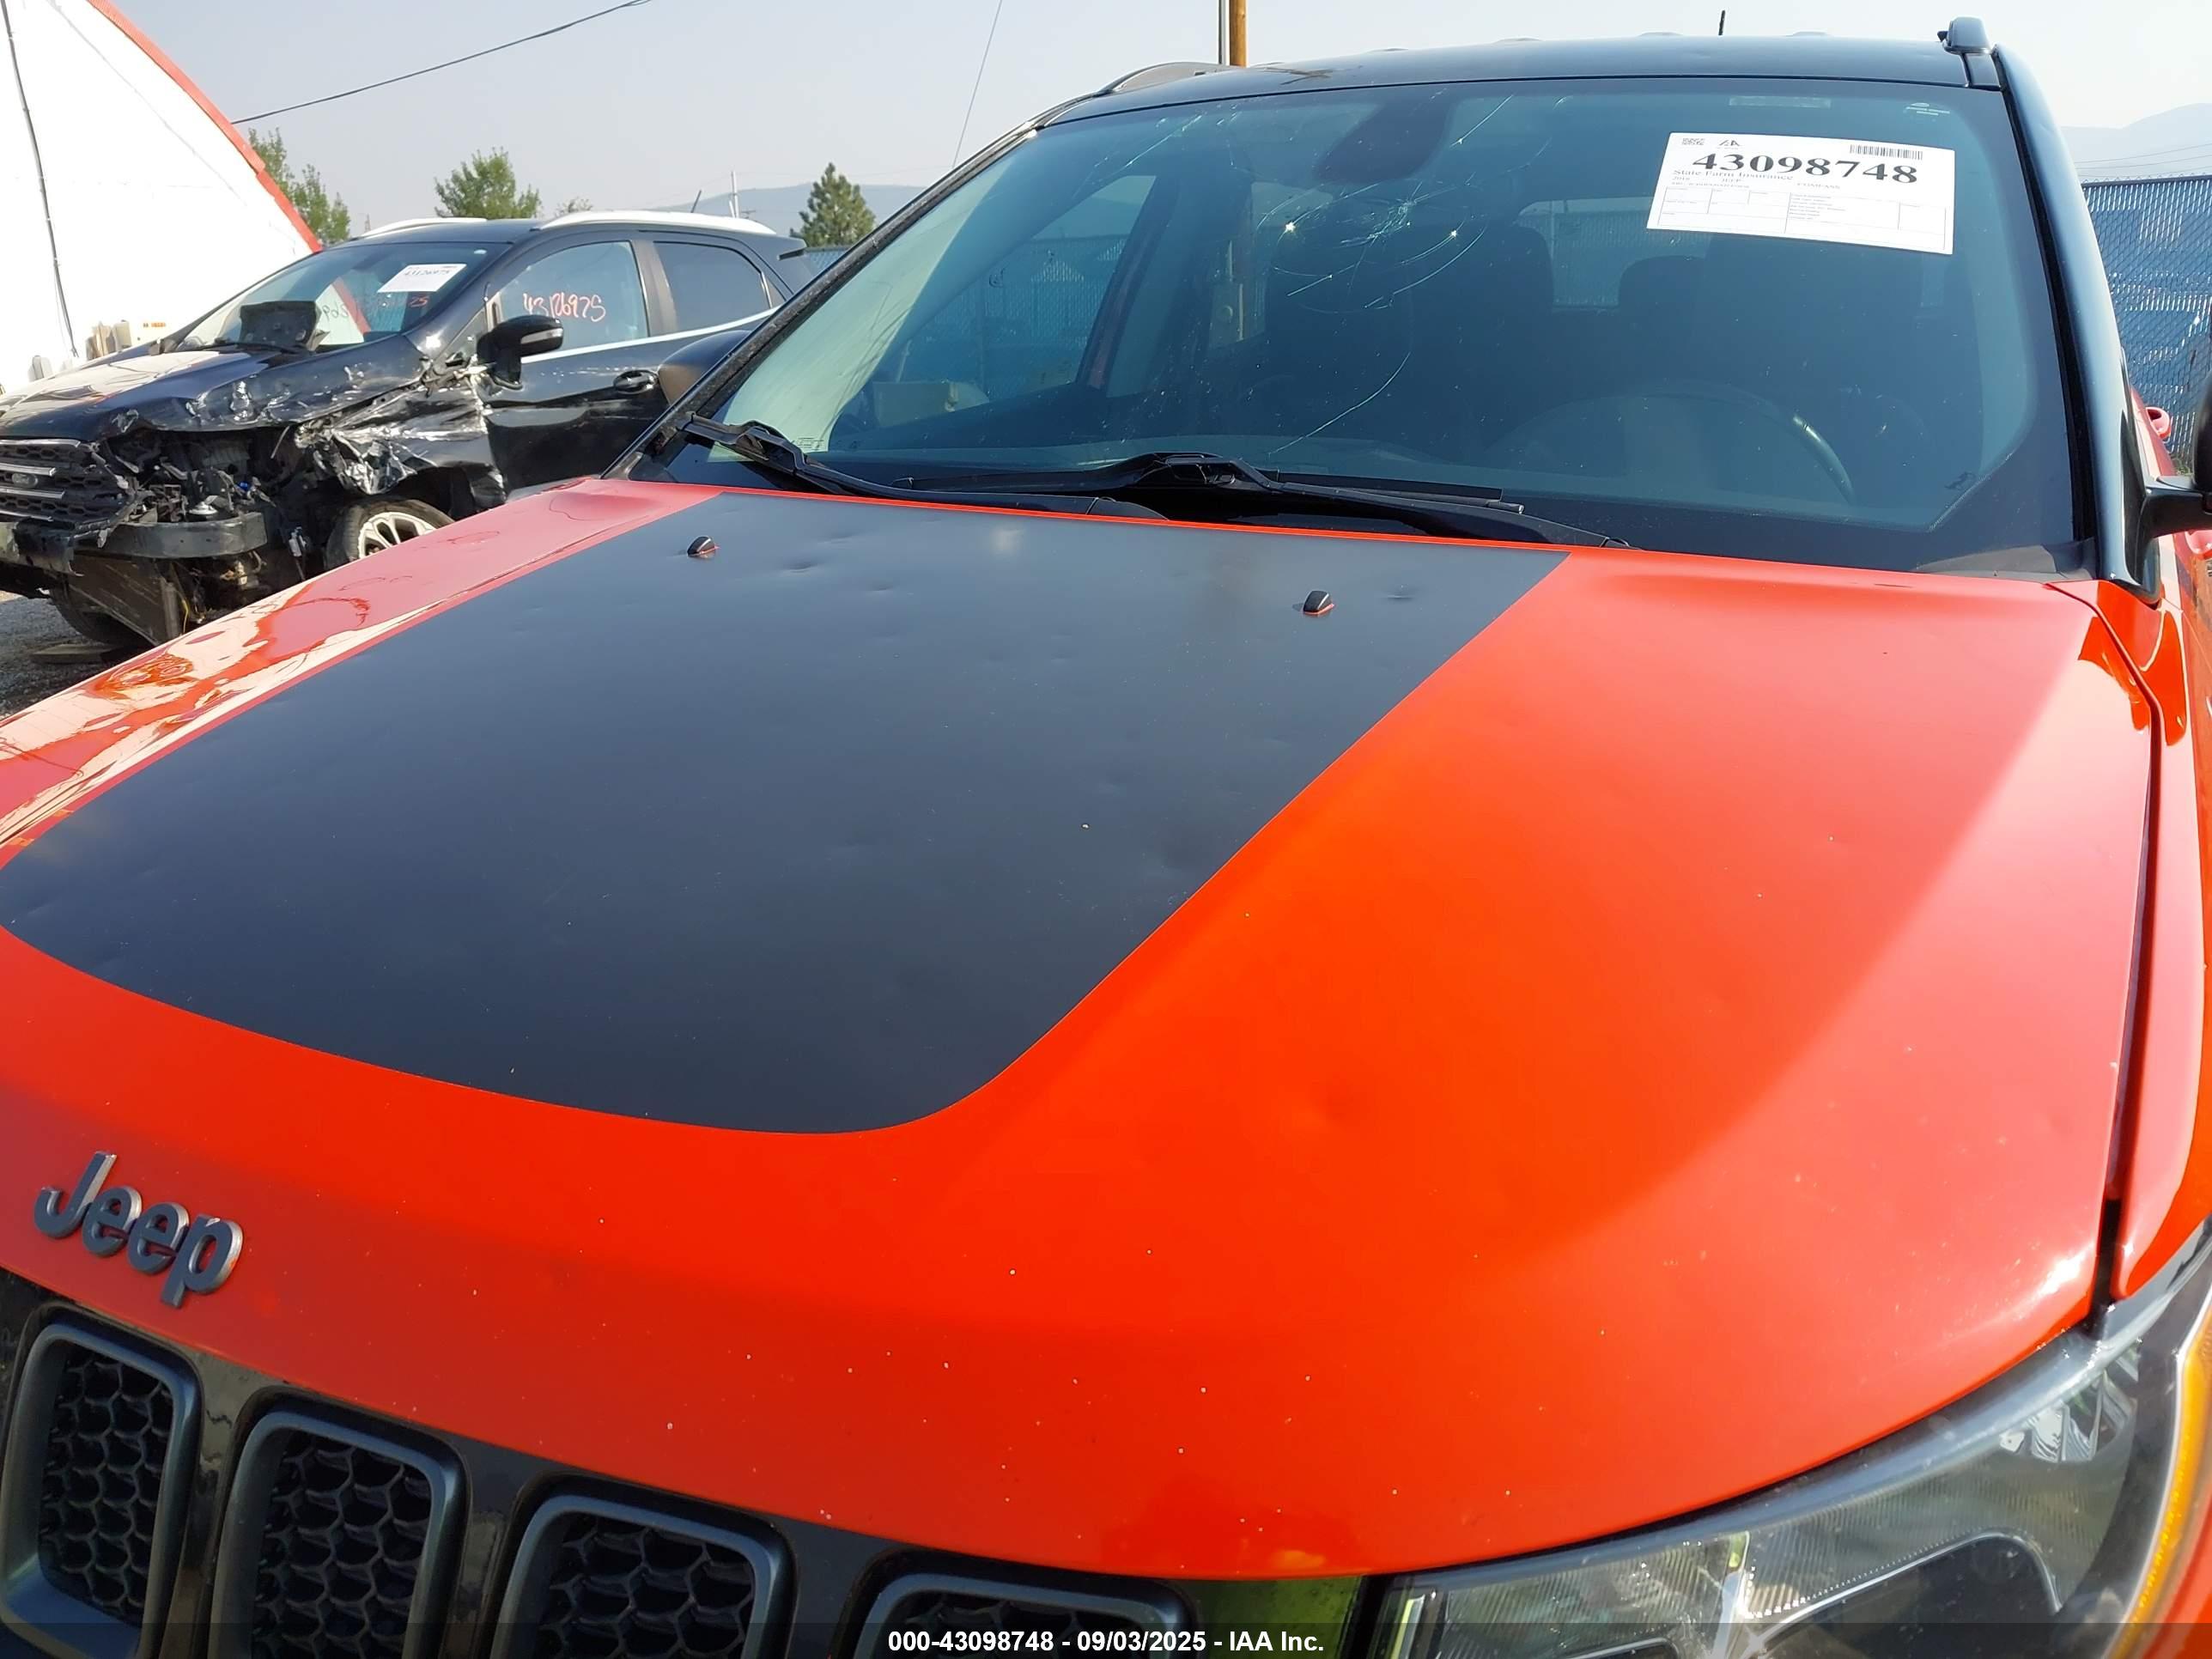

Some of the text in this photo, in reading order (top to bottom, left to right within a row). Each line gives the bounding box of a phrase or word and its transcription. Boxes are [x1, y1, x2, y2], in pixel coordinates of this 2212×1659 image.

[1692, 153, 1917, 184] 43098748
[522, 292, 606, 322] 43126975
[33, 1151, 245, 1309] Jeep
